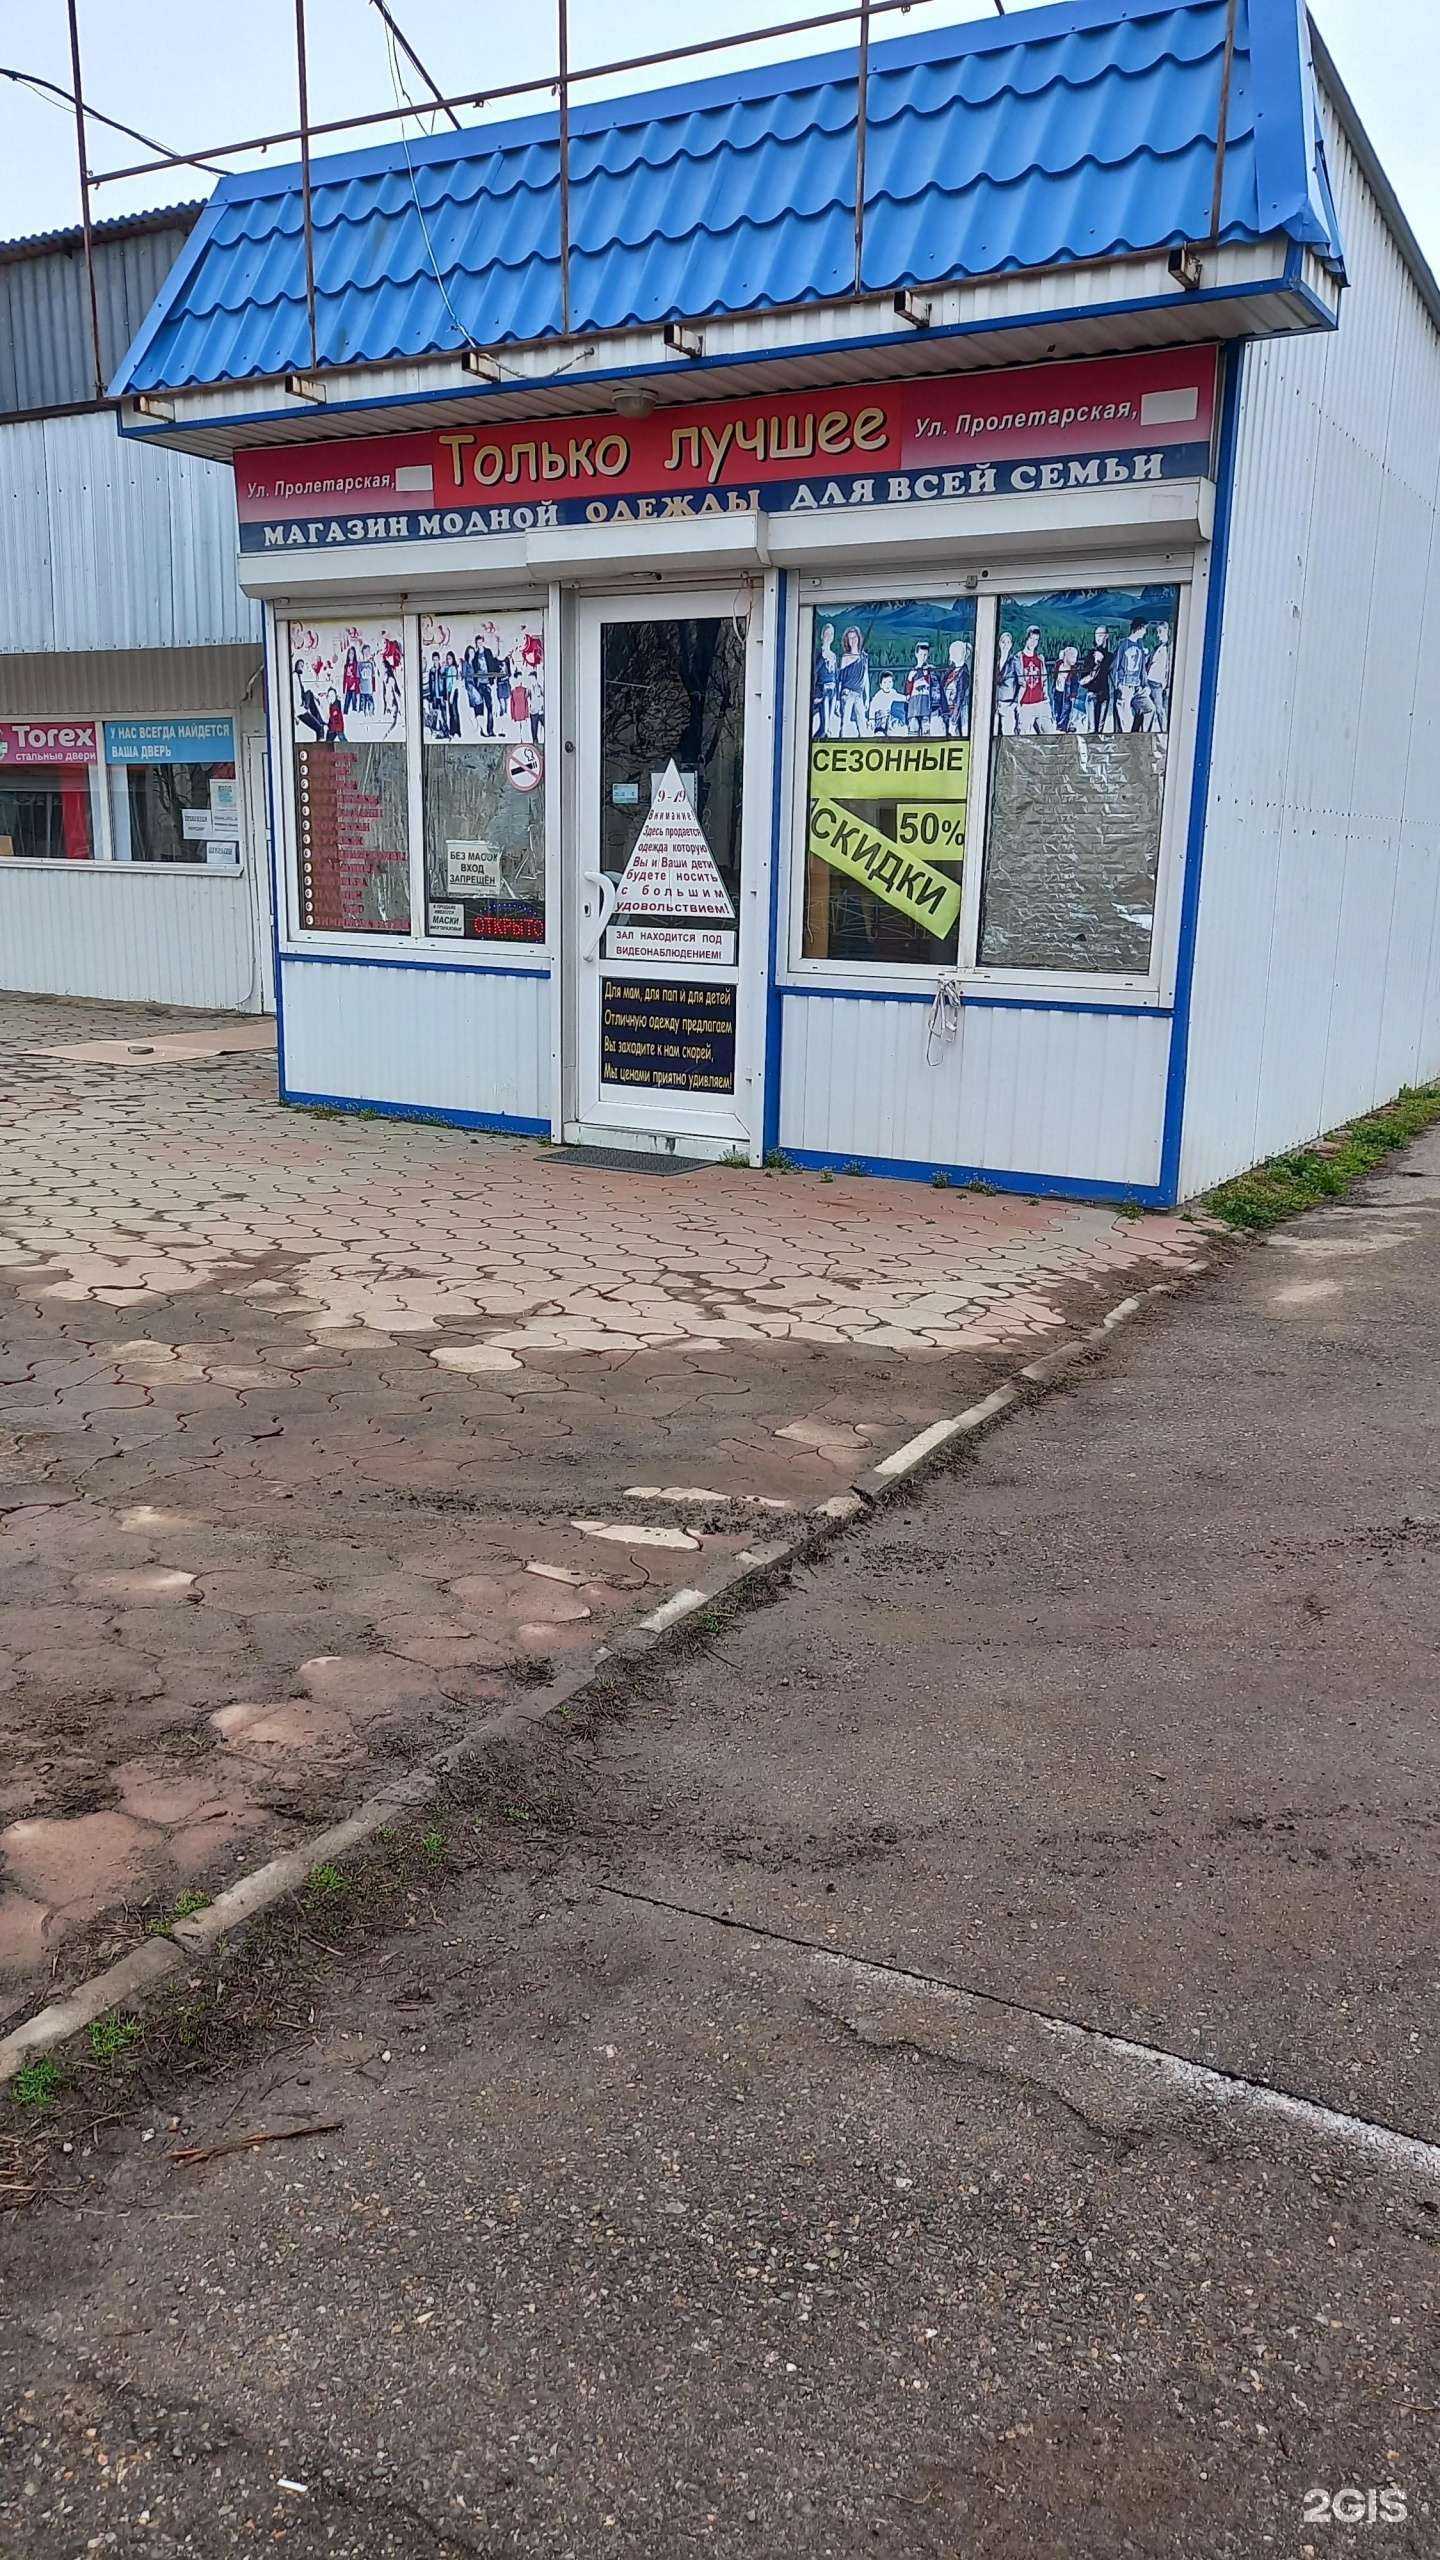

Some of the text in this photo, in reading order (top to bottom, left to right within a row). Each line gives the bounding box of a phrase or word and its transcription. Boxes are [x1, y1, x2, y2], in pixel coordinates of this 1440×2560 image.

[914, 402, 1137, 438] Ул. Пролетарская,
[438, 406, 889, 486] Только лучшее
[247, 472, 396, 498] Ул. Пролетарская,
[263, 453, 1164, 547] МАГАЗИН МОДНОЙ ОДЕЖДЫ ДЛЯ ВСЕЙ СЕМЬИ
[12, 725, 95, 748] Torex
[110, 723, 230, 740] У НАС ВСЕГДА НАЙДЕТСЯ
[16, 752, 96, 762] стальные двери
[112, 745, 172, 758] ВАША ДВЕРЬ
[813, 747, 964, 772] СЕЗОННЫЕ
[643, 825, 664, 837] Здесь
[900, 812, 965, 846] 50%
[450, 851, 498, 862] БЕЗ МАСОК
[638, 844, 708, 855] одежда которую
[460, 863, 485, 874] ВХОД
[633, 856, 649, 867] Вы
[661, 857, 688, 868] Ваши
[691, 860, 714, 870] дети
[810, 807, 948, 915] СКИДКИ
[626, 869, 718, 882] будете носить
[621, 885, 725, 898] с большим
[614, 901, 730, 914] удовольствием!
[432, 915, 460, 925] МАСКИ
[473, 916, 544, 936] ОТКРЫТО
[616, 930, 722, 945] ЗАЛ НАХОДИТСЯ ПОД
[616, 946, 722, 960] ВИДЕОНАБЛЮДЕНИЕМ!
[604, 981, 621, 1000] Для
[644, 987, 660, 1000] для
[680, 989, 686, 1002] и
[687, 990, 704, 1005] для
[705, 987, 731, 1006] детей
[604, 1008, 733, 1036] Отличную одежду предлагаем
[604, 1035, 714, 1063] Вы заходите к нам скорей,
[603, 1062, 733, 1090] Мы ценами приятно удивляем!
